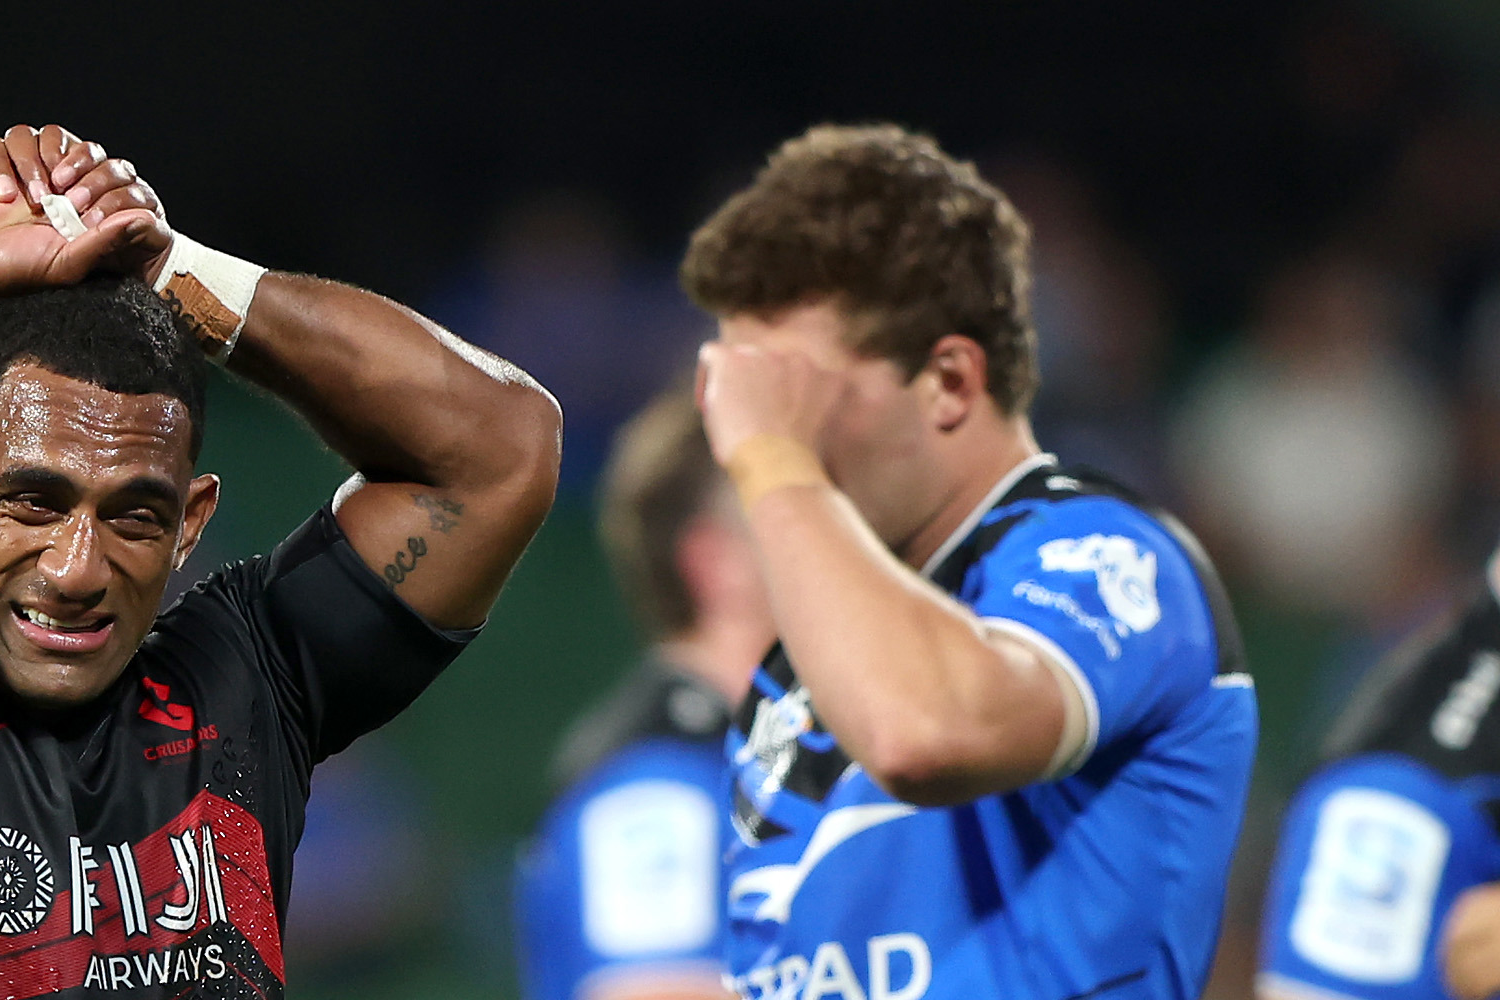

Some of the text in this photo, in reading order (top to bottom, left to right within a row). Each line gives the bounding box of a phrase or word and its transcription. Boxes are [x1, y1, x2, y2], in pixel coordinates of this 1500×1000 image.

[143, 723, 220, 761] CRUSARS
[69, 825, 228, 937] FIJI
[83, 944, 226, 990] AIRWAYS
